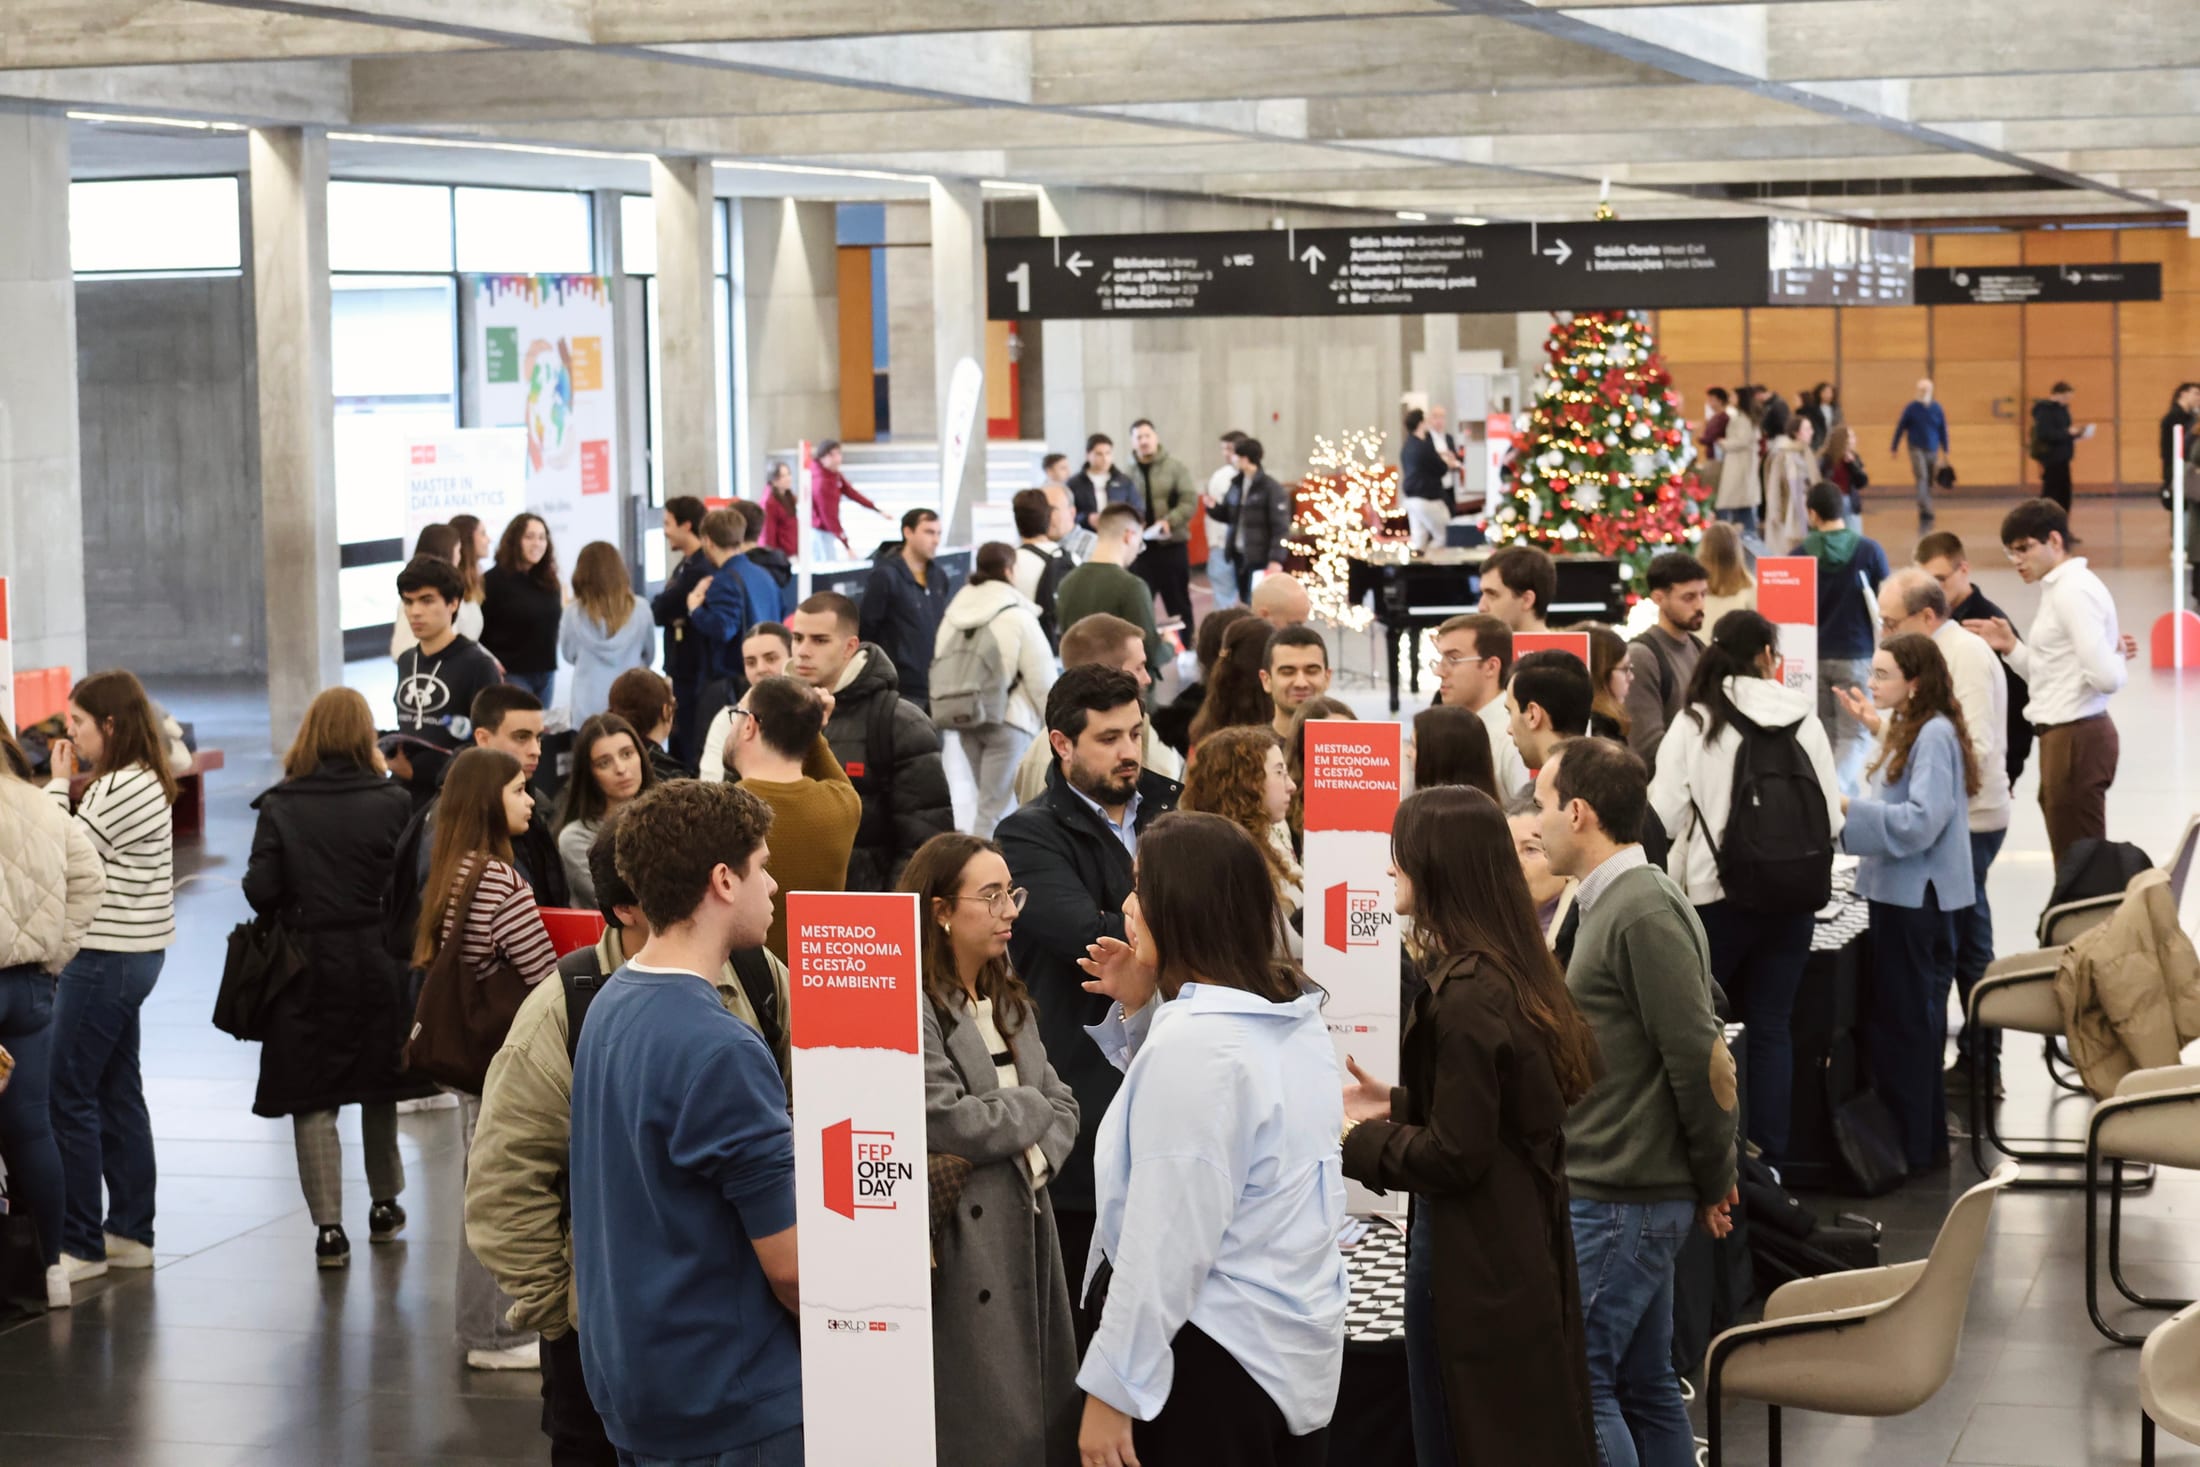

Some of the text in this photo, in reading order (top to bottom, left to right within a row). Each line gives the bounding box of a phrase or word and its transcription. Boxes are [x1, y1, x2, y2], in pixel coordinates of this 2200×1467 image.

[1006, 262, 1030, 313] 1
[411, 476, 473, 493] MASTER IN
[411, 491, 505, 511] DATA ANALYTICS
[1314, 743, 1372, 755] MESTRADO
[1314, 755, 1390, 767] EM ECONOMIA
[1314, 766, 1363, 778] E GESTÃO
[1314, 779, 1398, 791] INTERNACIONAL
[1351, 899, 1377, 912] FEP
[1350, 911, 1392, 925] OPEN
[801, 925, 876, 939] MESTRADO
[1351, 924, 1379, 937] DAY
[801, 941, 902, 956] EM ECONOMIA
[802, 956, 867, 972] E GESTÃO
[802, 975, 897, 989] DO AMBIENTE
[858, 1143, 892, 1161] FEP
[857, 1161, 912, 1180] OPEN
[859, 1179, 896, 1197] DAY
